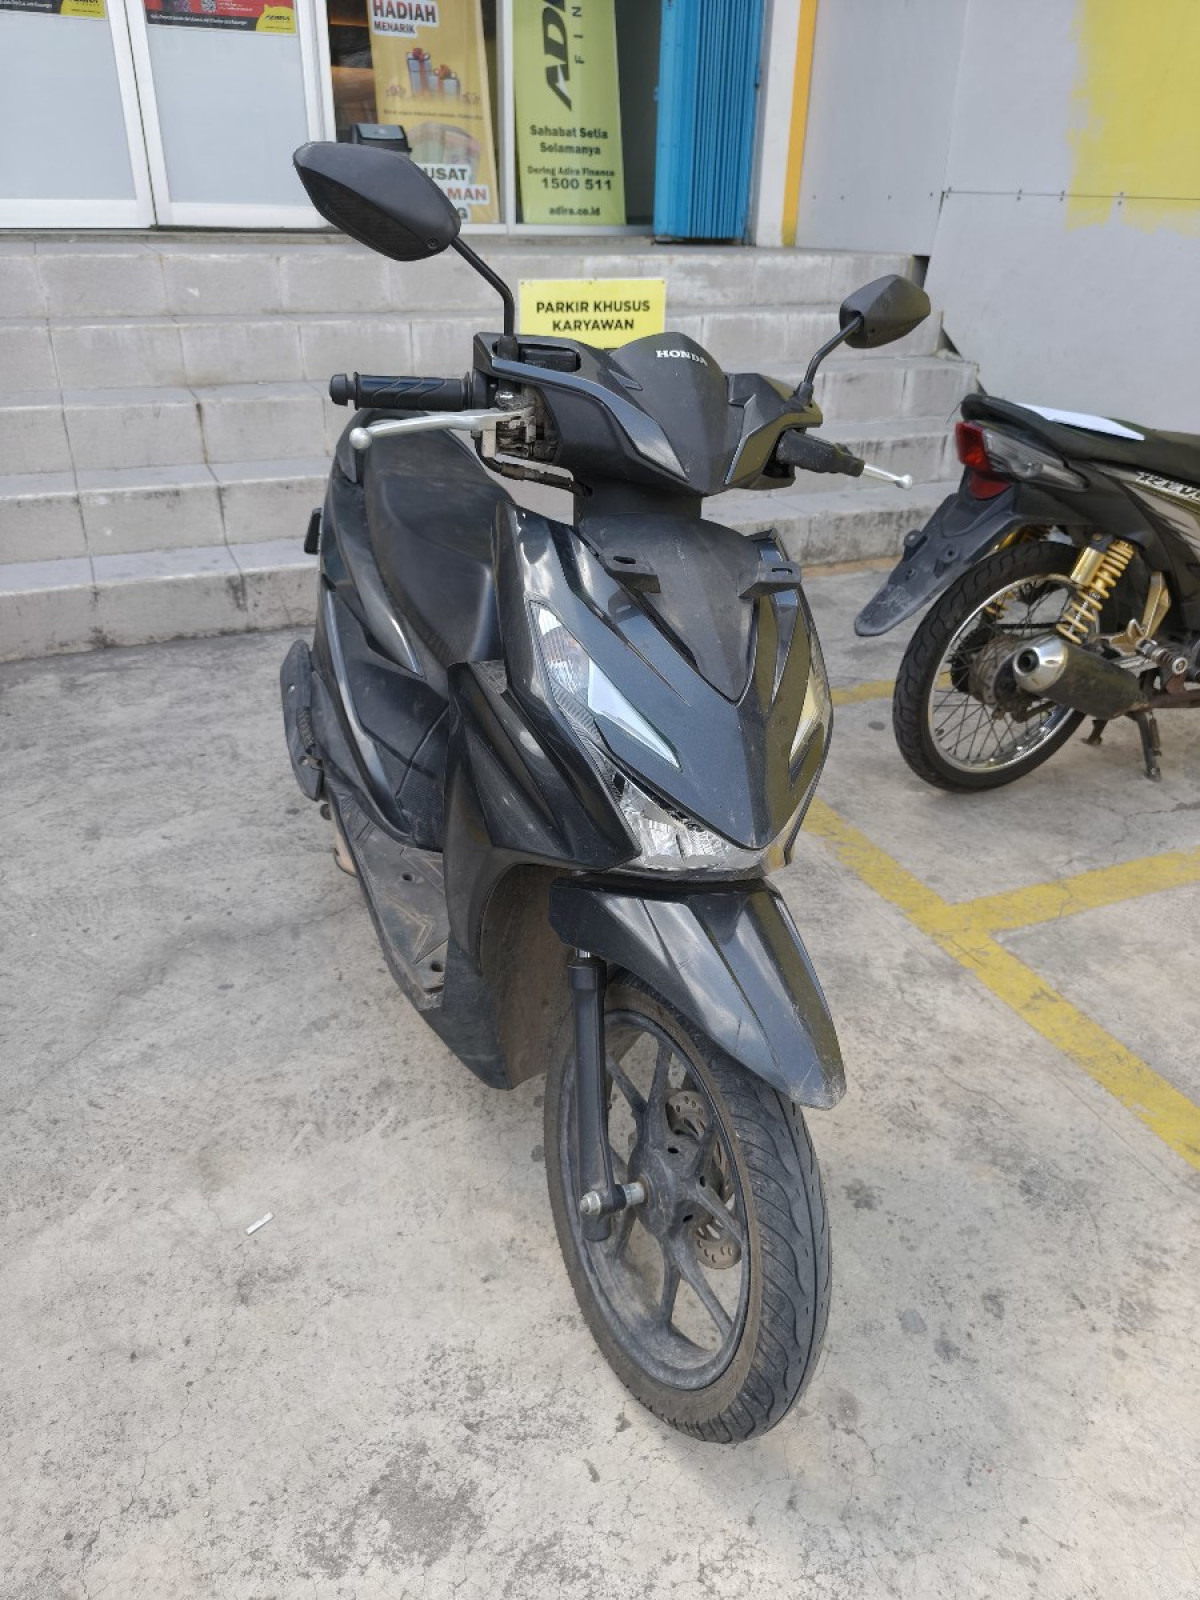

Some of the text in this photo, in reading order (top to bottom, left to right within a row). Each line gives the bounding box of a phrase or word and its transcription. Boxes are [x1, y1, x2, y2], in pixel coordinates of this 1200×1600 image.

[373, 0, 437, 23] HADIAH
[374, 21, 415, 34] MENARIK
[530, 124, 608, 139] Sahabat Setia
[540, 142, 601, 157] Selamanya
[423, 167, 467, 181] USAT
[527, 166, 615, 177] Dering Adira Finance
[541, 177, 611, 191] 1500 511
[549, 205, 601, 217] adira.co.id
[536, 300, 651, 314] PARKIR KHUSUS
[552, 319, 635, 332] KARYAWAN
[656, 349, 708, 366] HONDA
